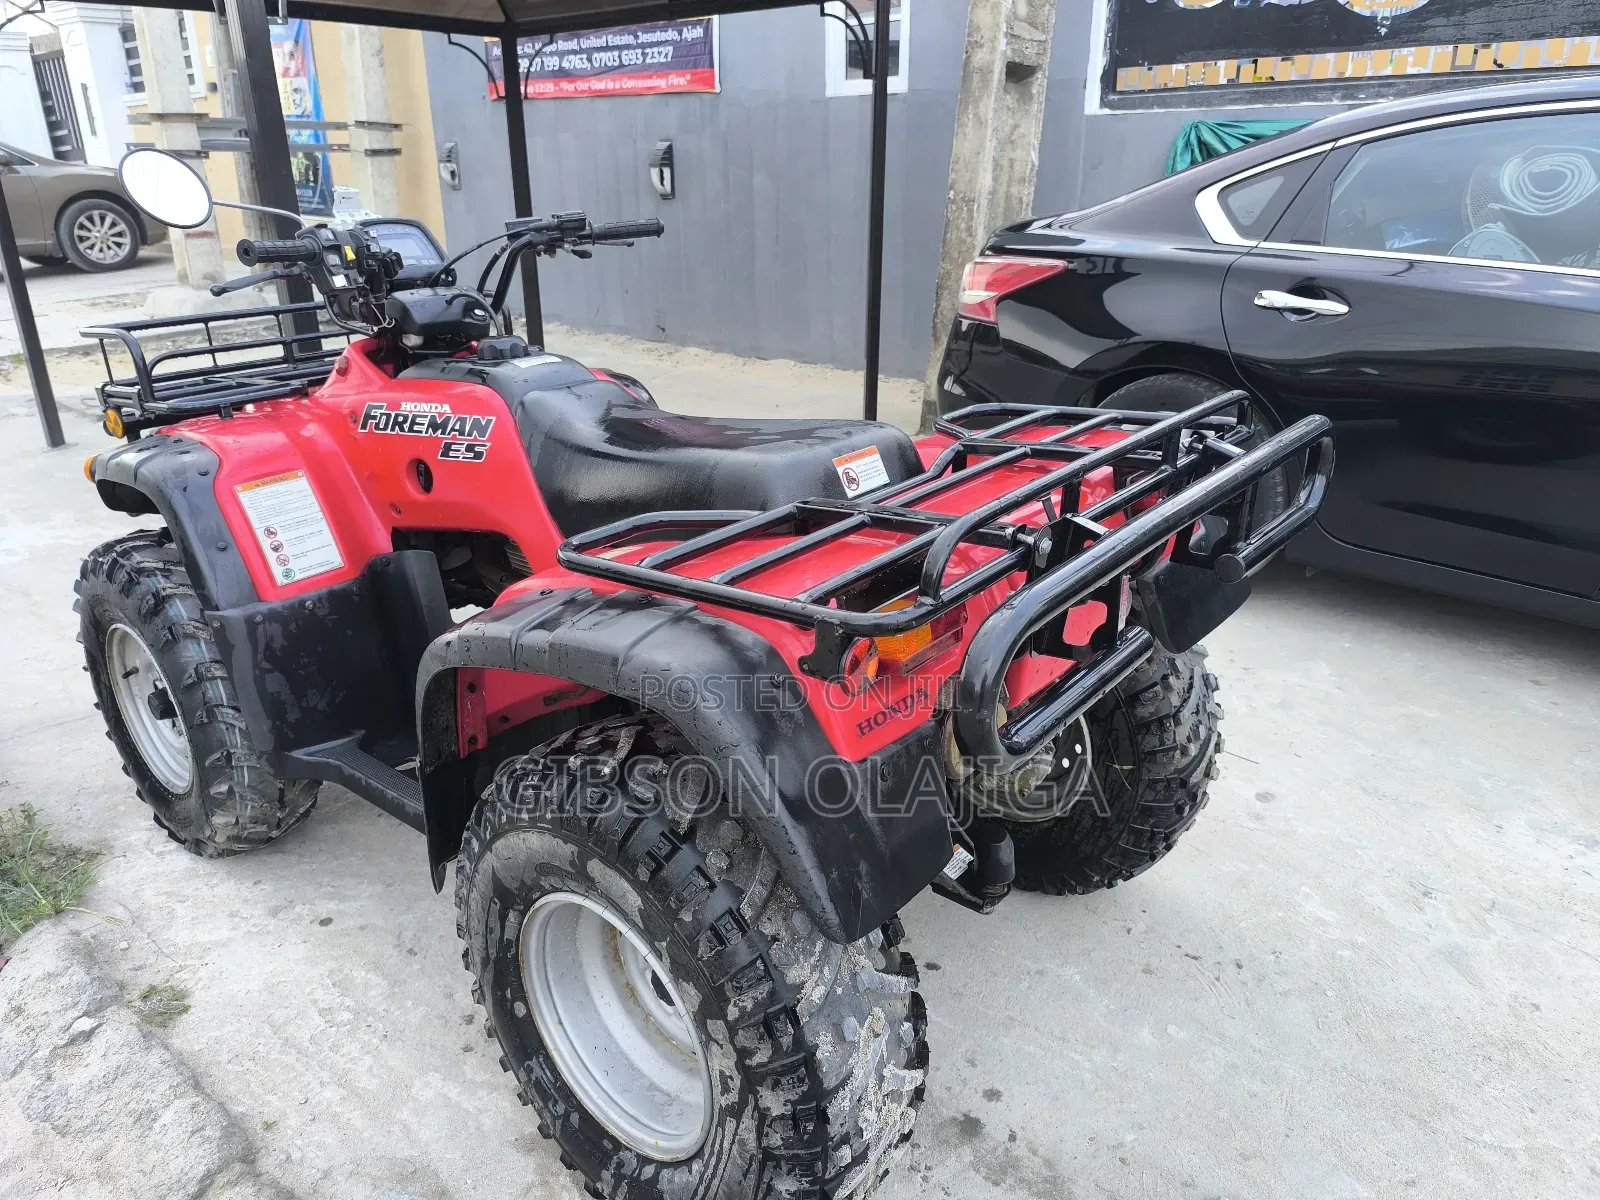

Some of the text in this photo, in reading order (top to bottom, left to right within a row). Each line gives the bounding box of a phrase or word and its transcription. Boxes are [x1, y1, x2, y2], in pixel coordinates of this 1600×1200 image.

[558, 39, 580, 51] Road,
[580, 36, 606, 49] United
[608, 33, 637, 46] Estate,
[637, 28, 681, 43] Jesutedo,
[682, 25, 704, 41] Ajah
[542, 55, 560, 71] 199
[561, 53, 592, 70] 4763,
[592, 51, 620, 68] 0703
[621, 48, 643, 65] 693
[644, 46, 674, 64] 2327
[576, 81, 590, 91] Our
[590, 80, 606, 90] God
[607, 79, 614, 89] is
[615, 80, 621, 89] a
[621, 76, 667, 89] Consuming
[400, 401, 452, 414] HONDA
[358, 402, 496, 440] FOREMAN
[438, 440, 491, 462] ES
[856, 687, 929, 739] HONDA
